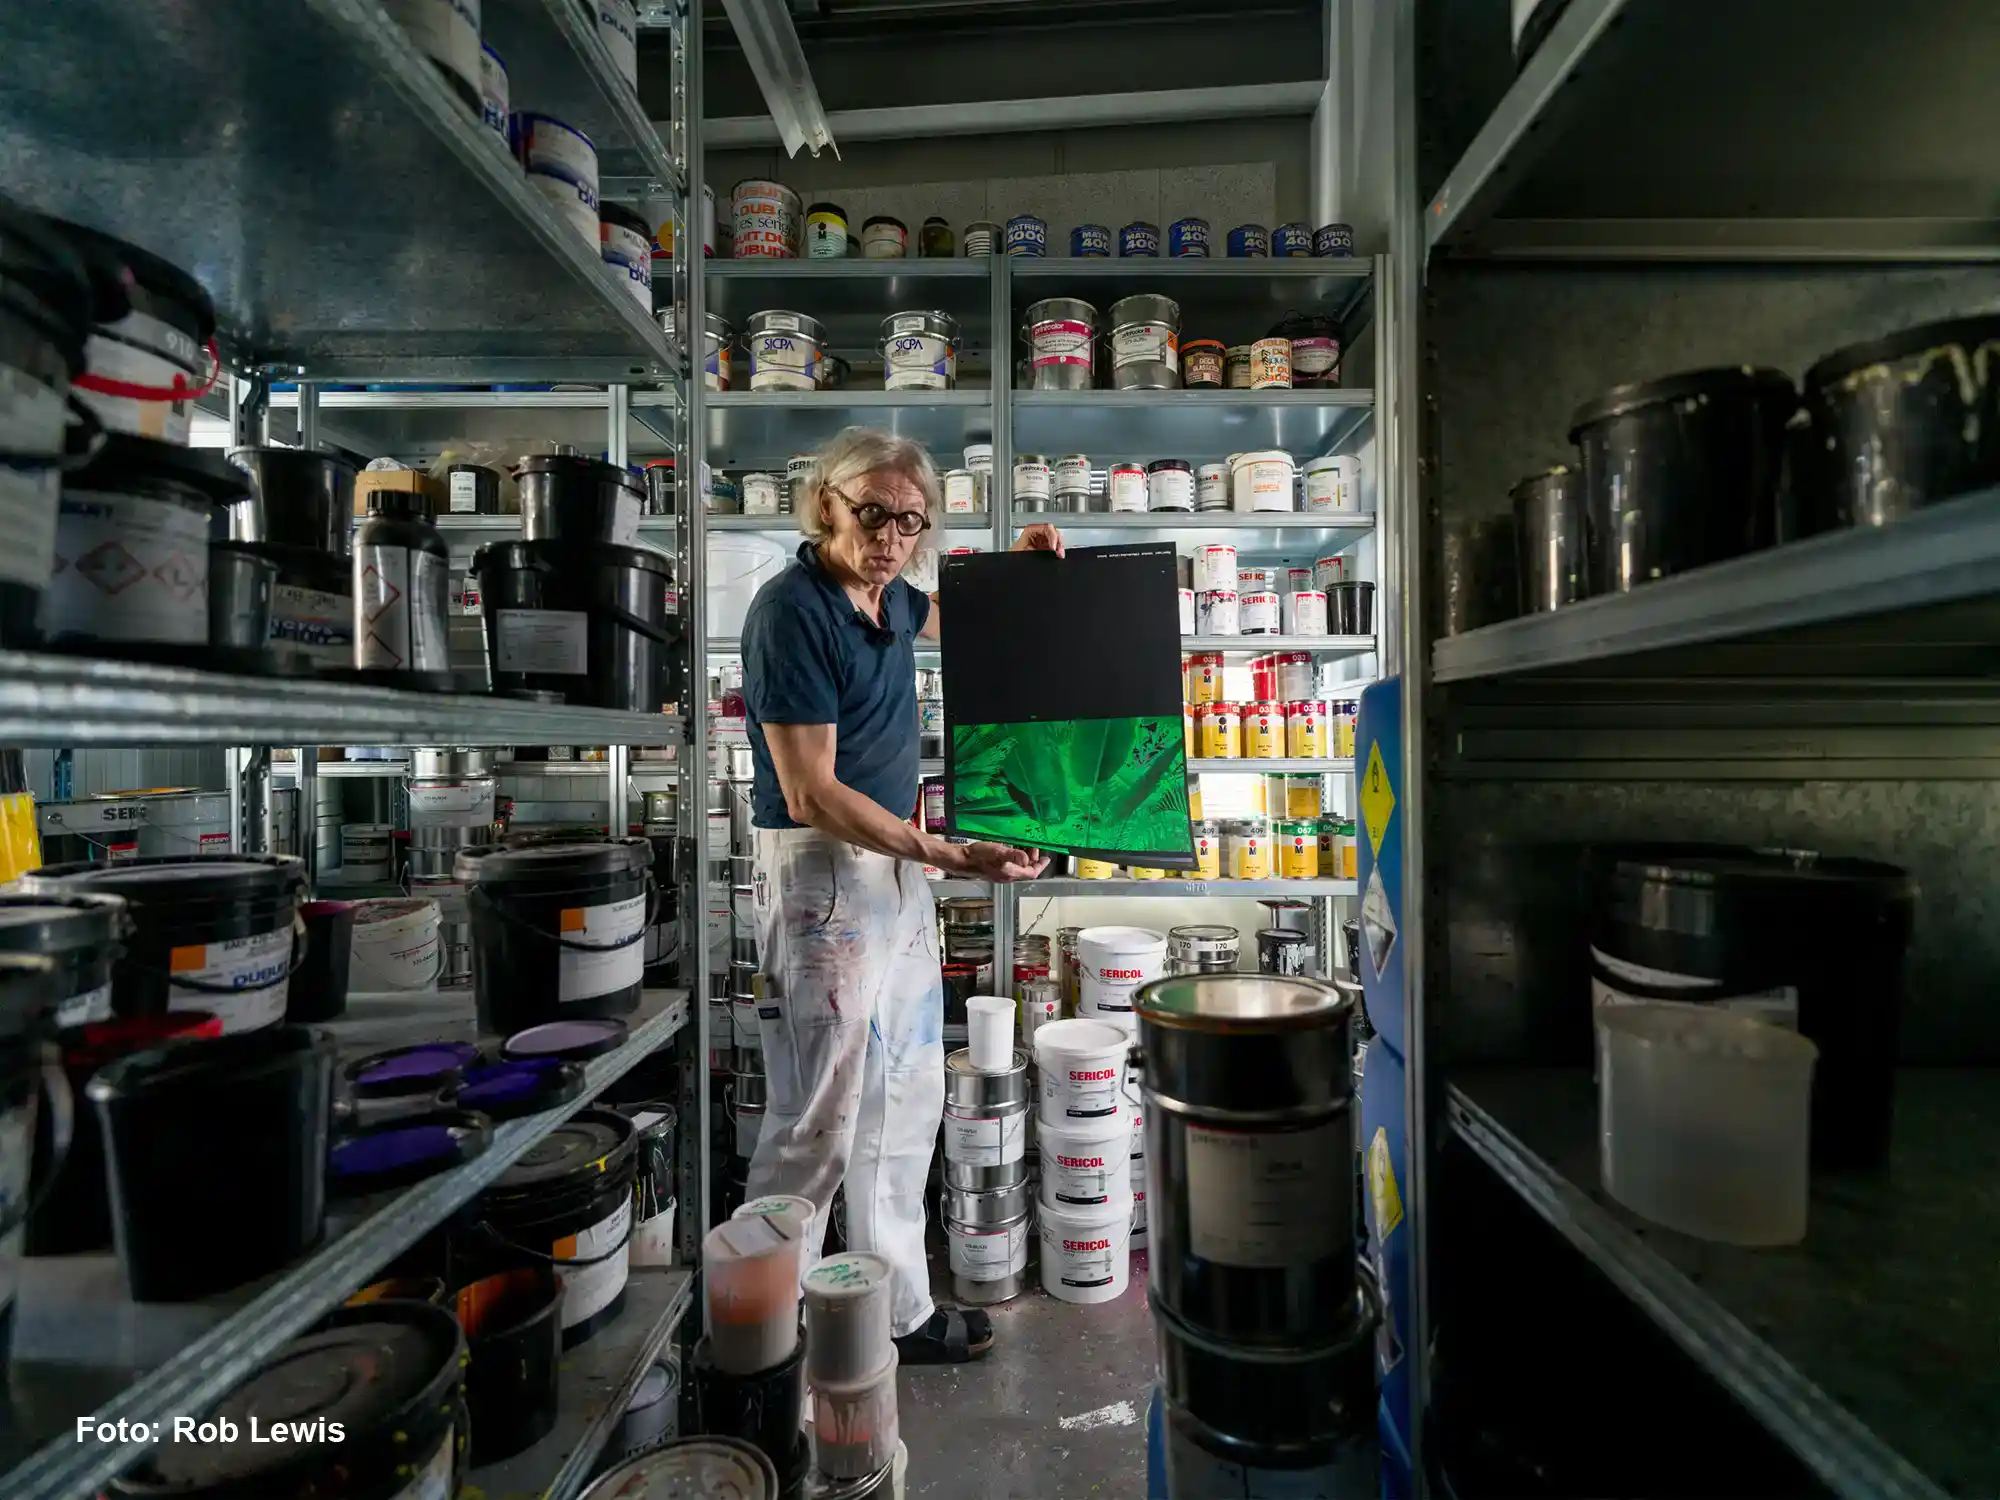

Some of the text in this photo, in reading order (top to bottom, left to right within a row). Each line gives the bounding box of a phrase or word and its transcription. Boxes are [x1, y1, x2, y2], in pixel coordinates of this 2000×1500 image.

[764, 338, 795, 352] SICPA
[895, 338, 924, 352] SICPA
[1179, 941, 1191, 949] 170
[1215, 942, 1228, 950] 170
[1099, 968, 1144, 979] SERICOL
[1069, 1068, 1116, 1081] SERICOL
[1056, 1155, 1105, 1168] SERICOL
[1062, 1239, 1111, 1252] SERICOL
